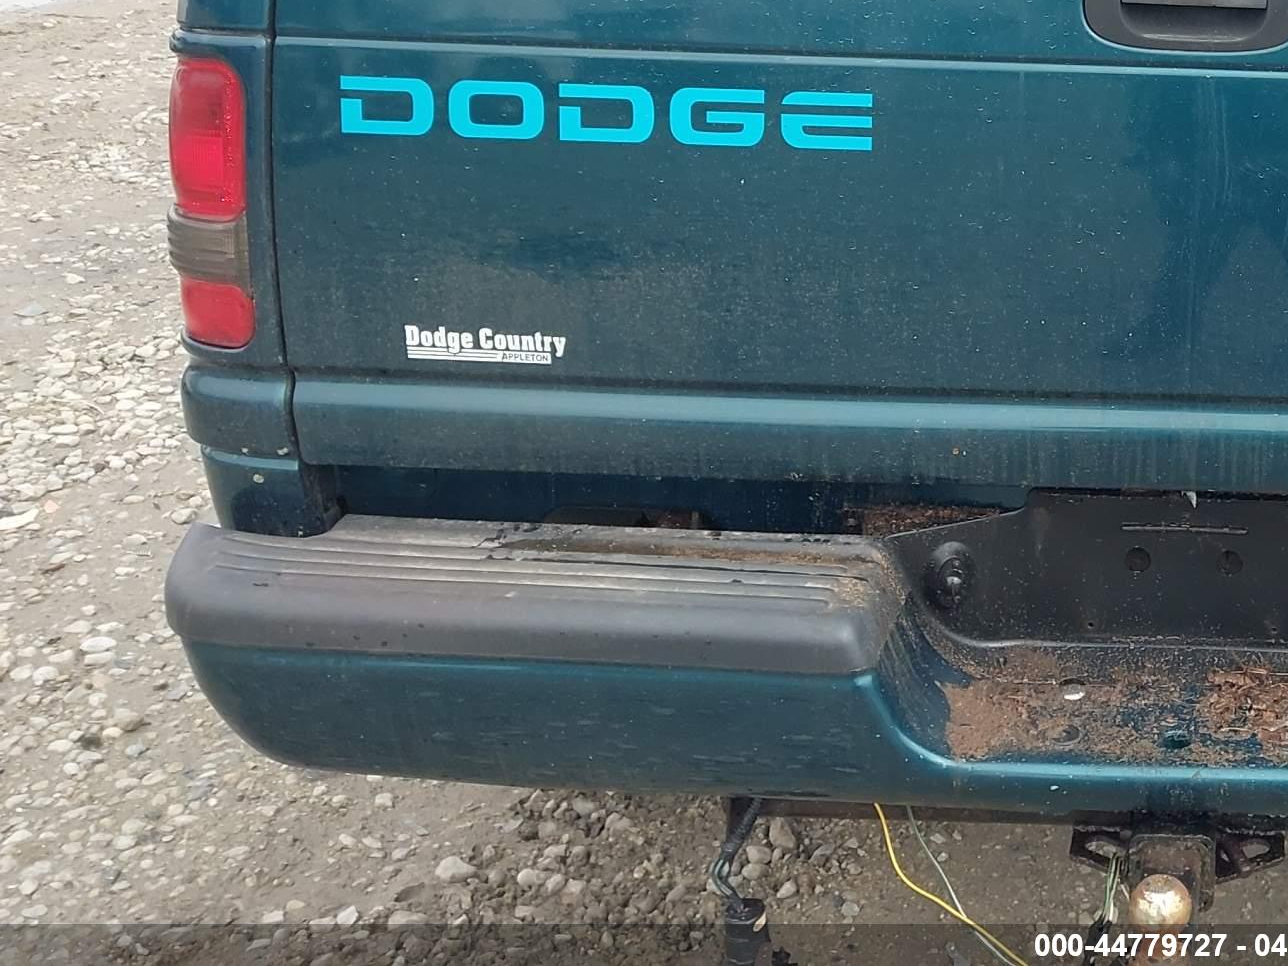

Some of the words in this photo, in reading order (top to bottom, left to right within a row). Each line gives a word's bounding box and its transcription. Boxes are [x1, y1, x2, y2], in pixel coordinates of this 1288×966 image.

[340, 75, 873, 151] DODGE
[404, 325, 473, 354] Dodge
[478, 327, 567, 358] Country
[501, 352, 549, 362] APPLETON
